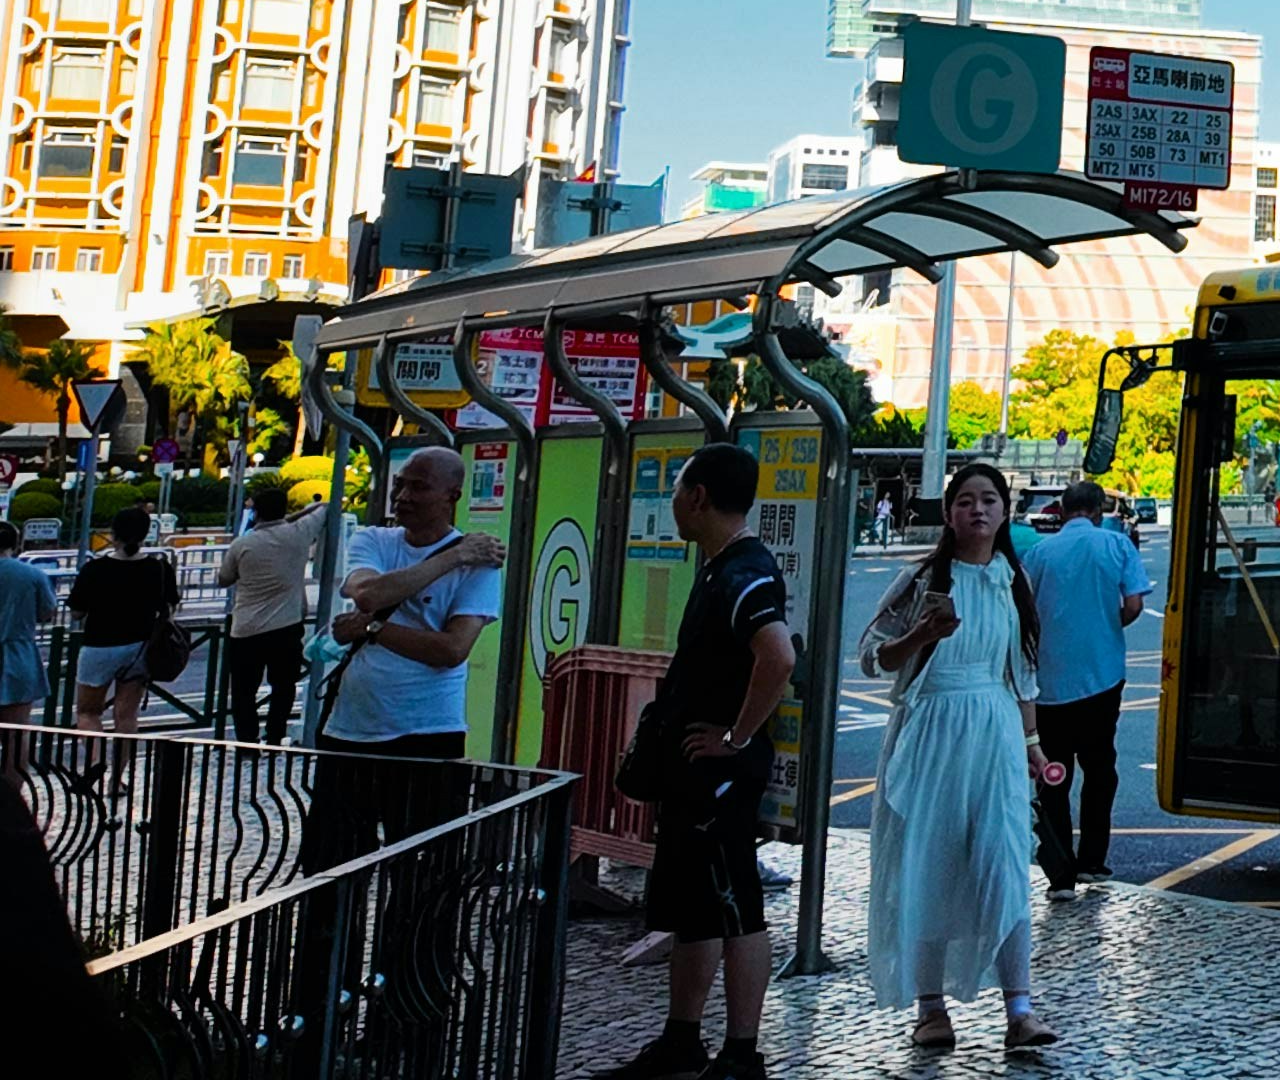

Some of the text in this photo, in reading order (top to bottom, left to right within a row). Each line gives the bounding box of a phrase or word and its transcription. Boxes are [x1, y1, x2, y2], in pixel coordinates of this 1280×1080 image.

[1091, 76, 1126, 90] 巴士站
[1132, 64, 1225, 94] 亞馬喇前地
[1096, 104, 1222, 128] 2AS 3AX 22 25
[1095, 123, 1221, 146] 25AX 25B 28A 39
[1099, 143, 1225, 166] 50 50B 73 MT1
[1092, 161, 1155, 178] MT2 MT5
[1130, 187, 1192, 207] M172/16
[612, 333, 639, 344] TCM
[396, 359, 441, 381] 關閘
[759, 504, 796, 546] 關閘
